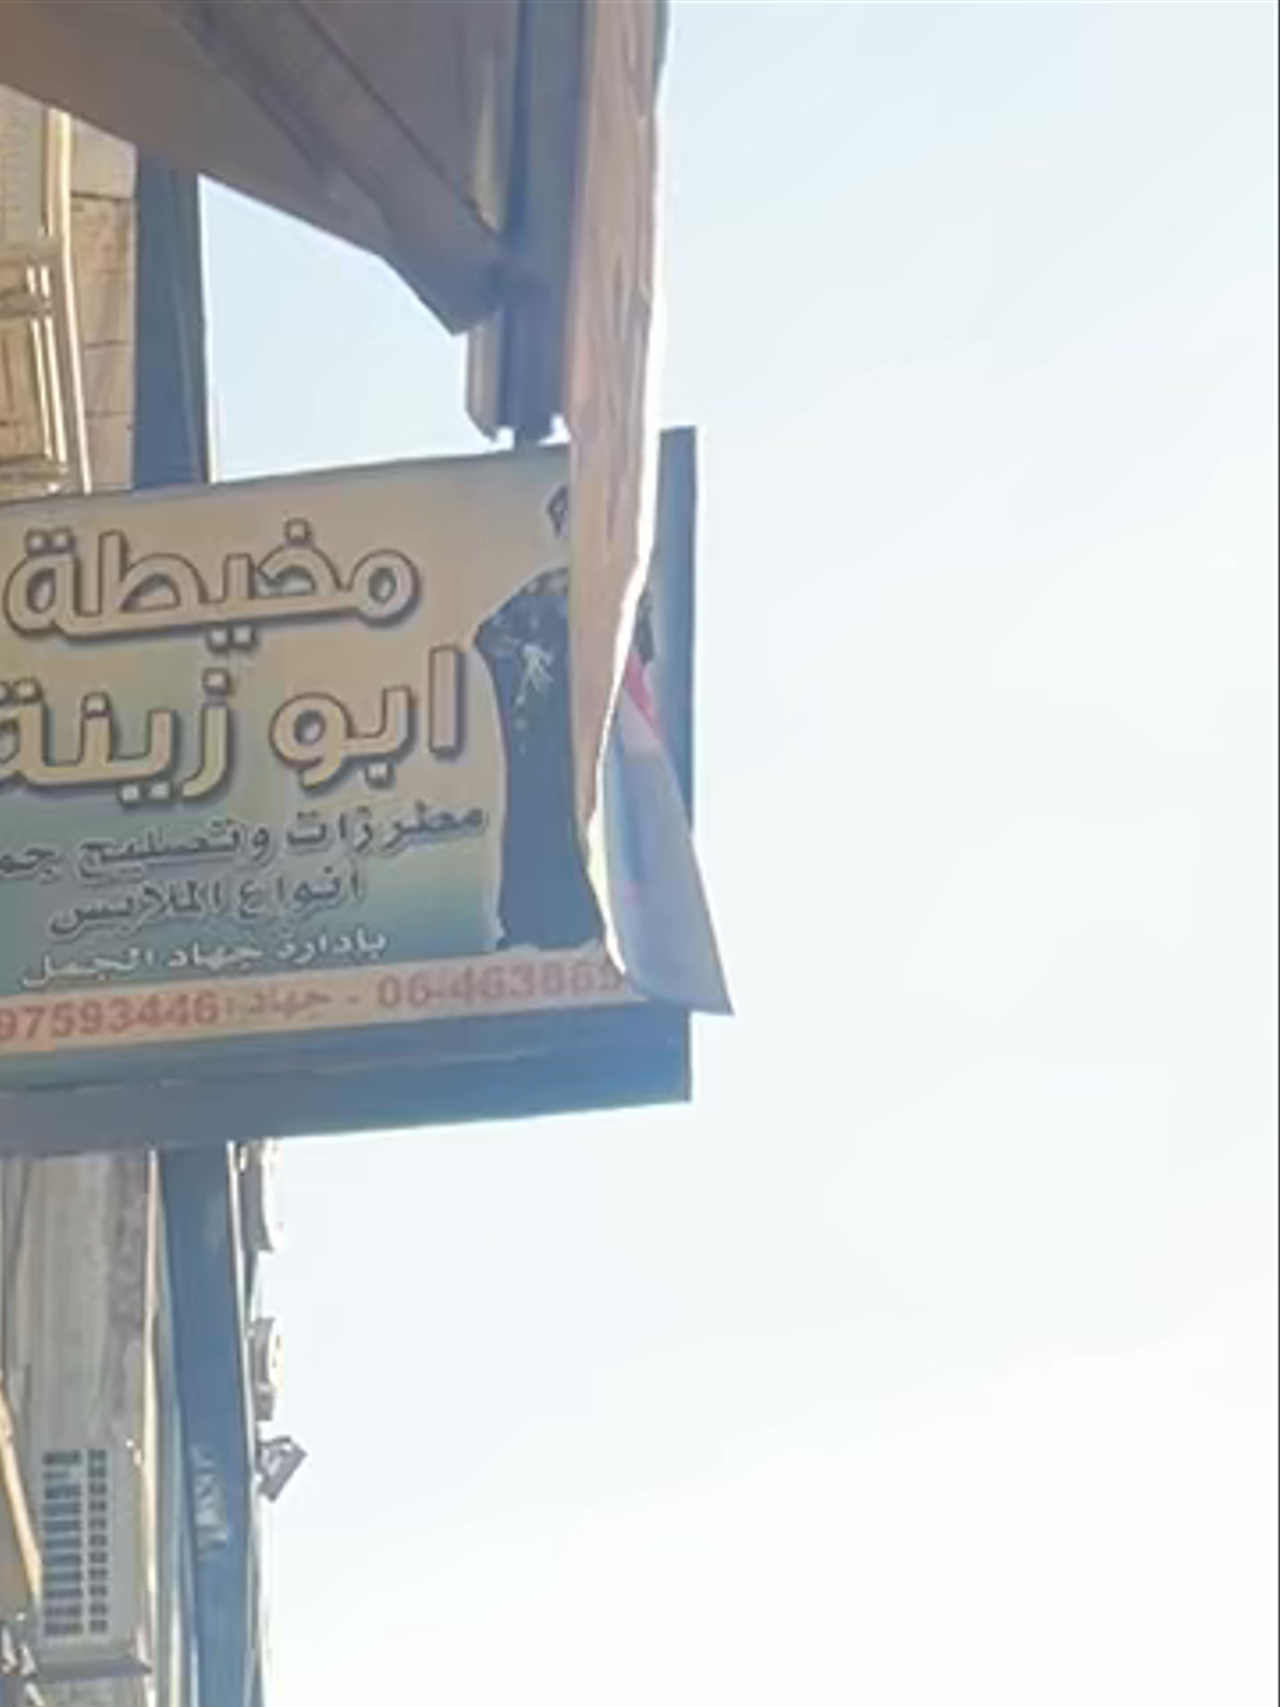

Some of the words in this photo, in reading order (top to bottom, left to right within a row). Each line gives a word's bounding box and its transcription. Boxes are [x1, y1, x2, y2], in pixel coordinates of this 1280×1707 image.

[2, 518, 420, 652] مخيطة
[269, 645, 462, 792] ابو
[78, 818, 271, 880] وتصليح
[284, 800, 486, 856] مطرزات
[49, 879, 223, 936] الملابس
[167, 940, 263, 971] جهاد
